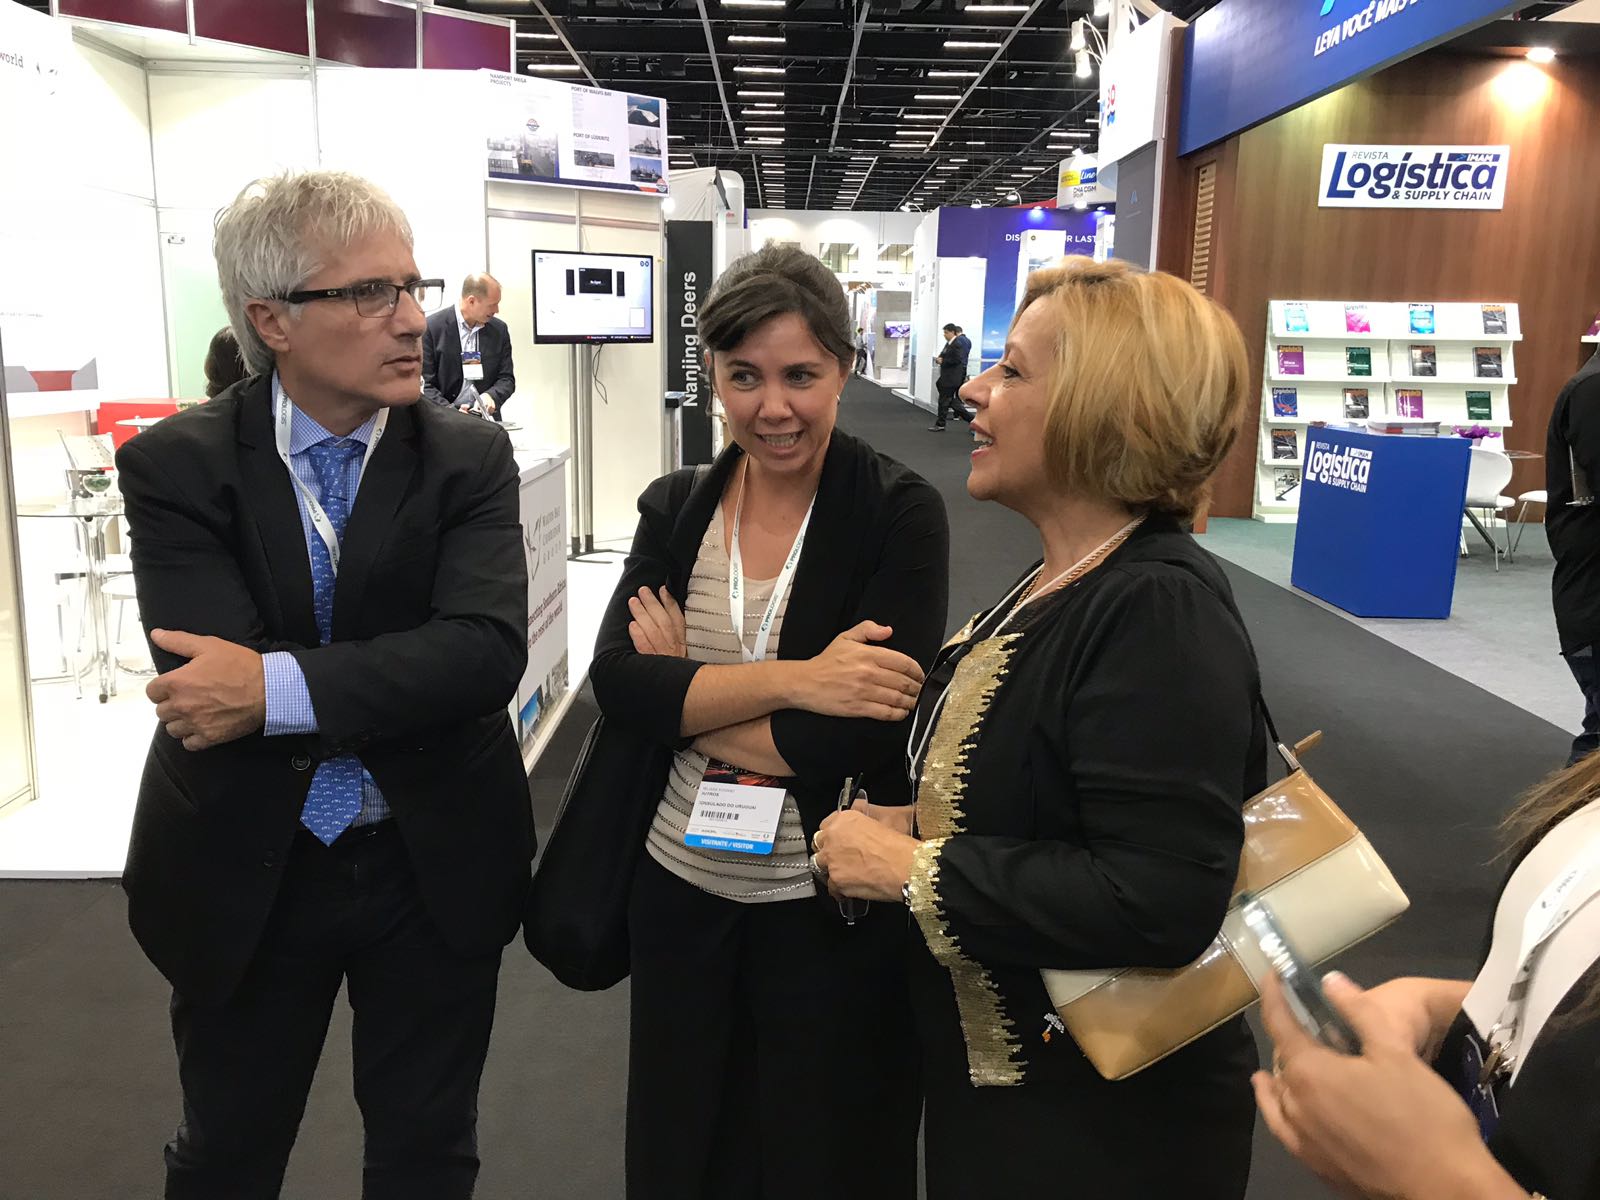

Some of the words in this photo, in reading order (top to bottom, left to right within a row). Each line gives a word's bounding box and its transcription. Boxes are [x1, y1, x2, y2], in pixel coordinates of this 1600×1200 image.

[1313, 24, 1341, 56] LEVA
[1341, 1, 1376, 41] VOCÊ
[1352, 151, 1389, 160] REVISTA
[1466, 153, 1493, 163] IMAM
[1391, 190, 1401, 200] &
[1404, 190, 1450, 201] SUPPLY
[1453, 191, 1492, 201] CHAIN
[681, 271, 697, 328] Deers
[682, 334, 701, 407] Nanjing
[1332, 477, 1351, 489] SUPPLY
[1350, 481, 1367, 493] CHAIN
